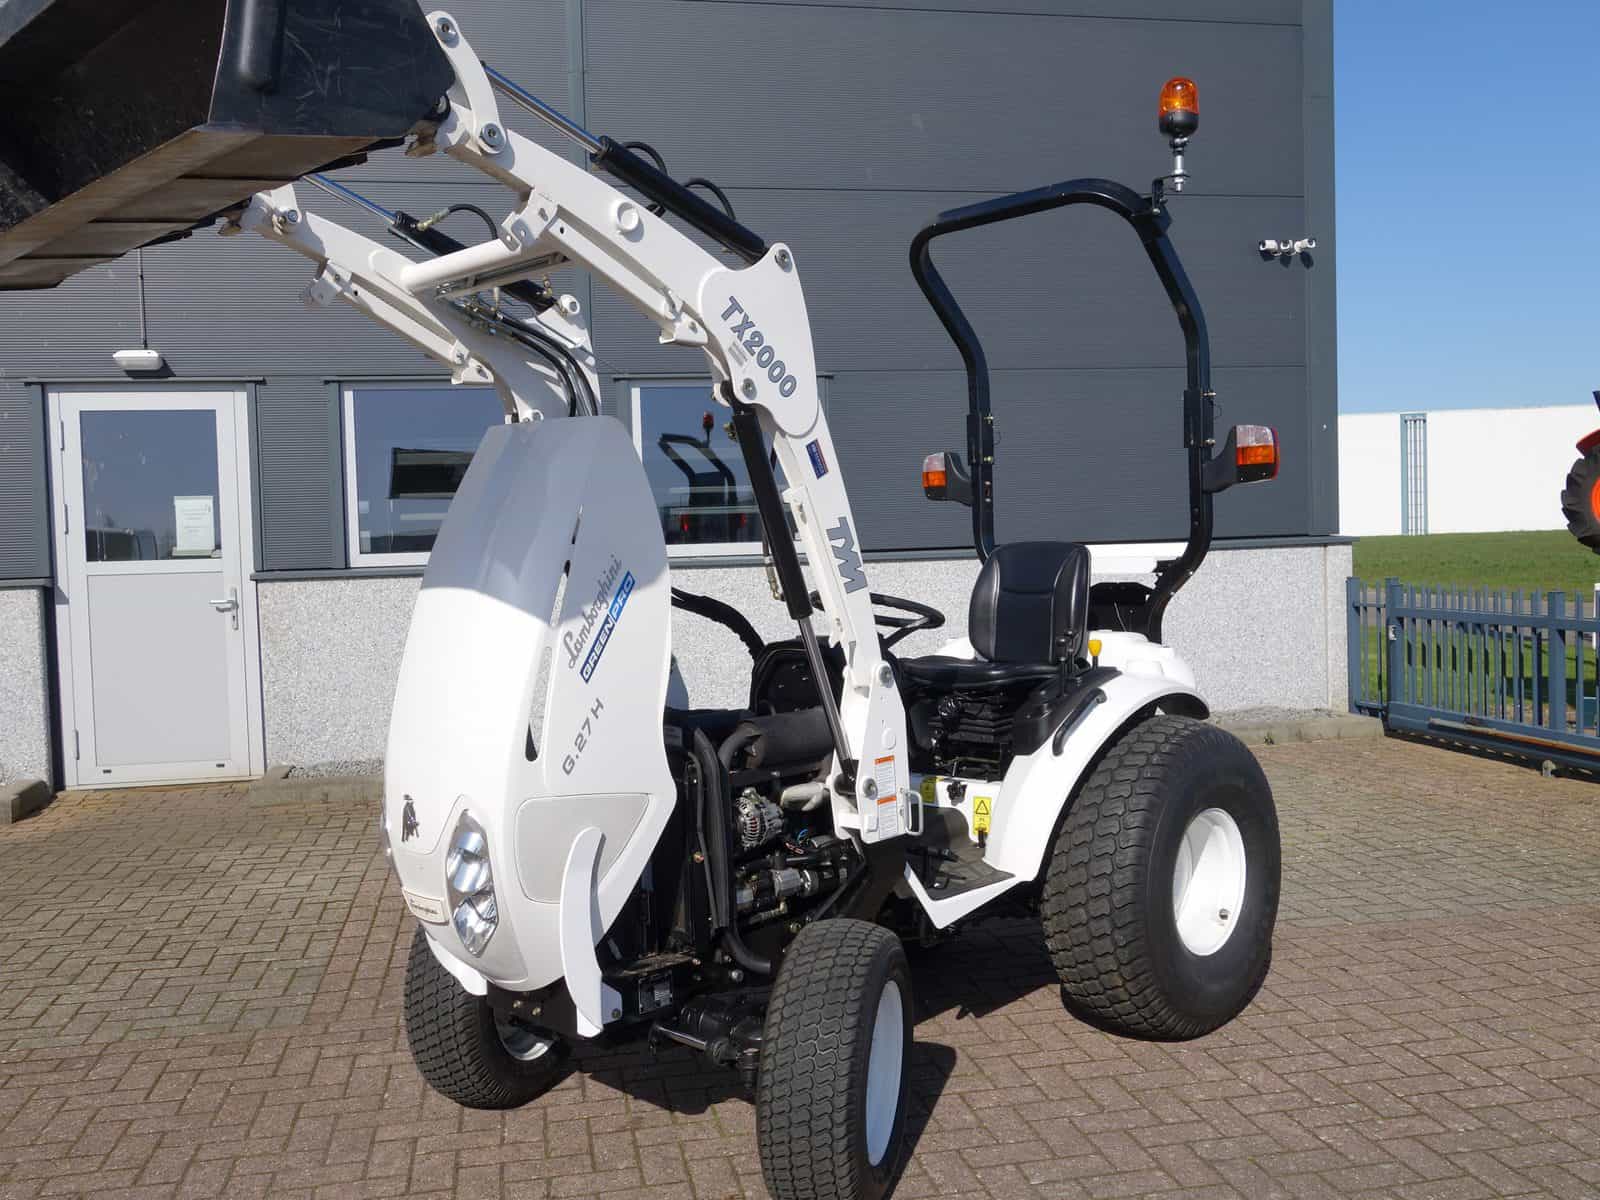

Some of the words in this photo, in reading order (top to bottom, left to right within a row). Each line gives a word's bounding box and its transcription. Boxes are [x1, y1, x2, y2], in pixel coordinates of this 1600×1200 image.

[721, 296, 797, 398] TX2000
[826, 516, 868, 594] TYM
[563, 554, 622, 669] Lamborghini
[581, 617, 615, 681] GREEN
[612, 574, 635, 620] PRO
